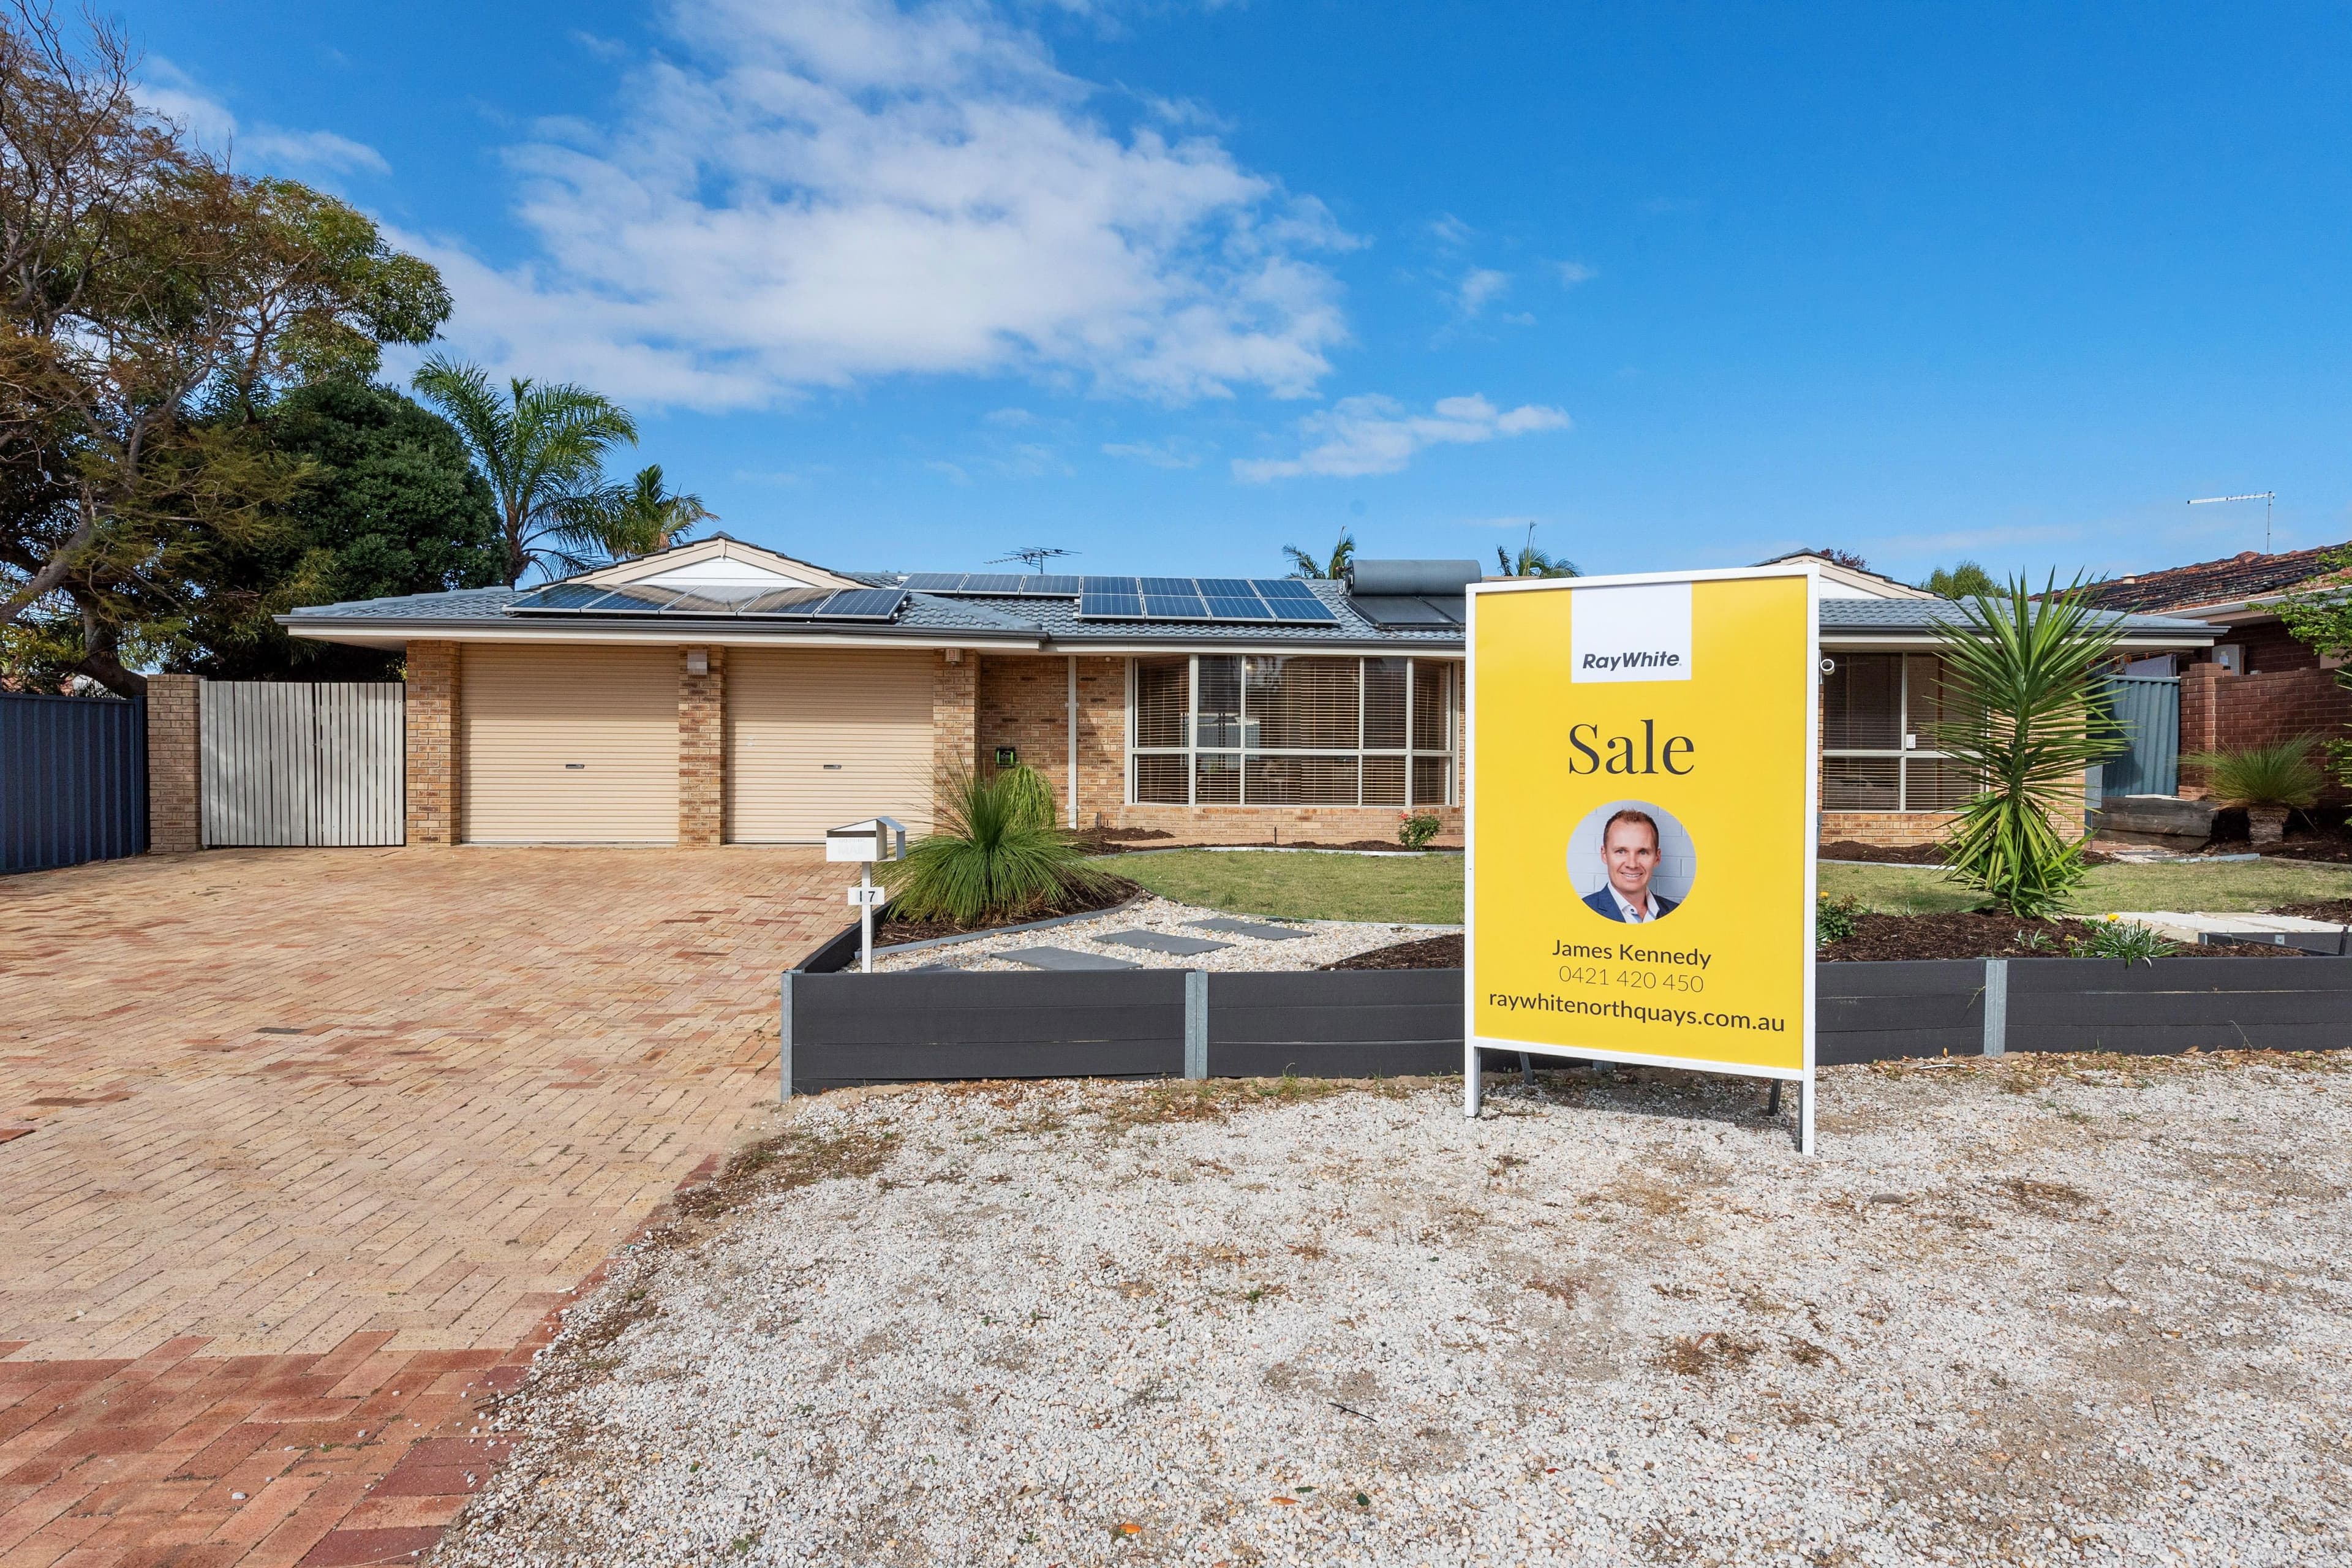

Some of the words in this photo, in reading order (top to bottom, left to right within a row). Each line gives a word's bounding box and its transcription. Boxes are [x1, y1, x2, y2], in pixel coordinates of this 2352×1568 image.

[1569, 718, 1695, 775] Sale
[859, 891, 876, 903] 17
[1551, 939, 1613, 960] James
[1619, 943, 1712, 970] Kennedy
[1559, 965, 1609, 986] 0421
[1616, 970, 1656, 989] 420
[1662, 974, 1704, 993] 450
[1490, 992, 1785, 1032] raywhitenorthquays.com.au
